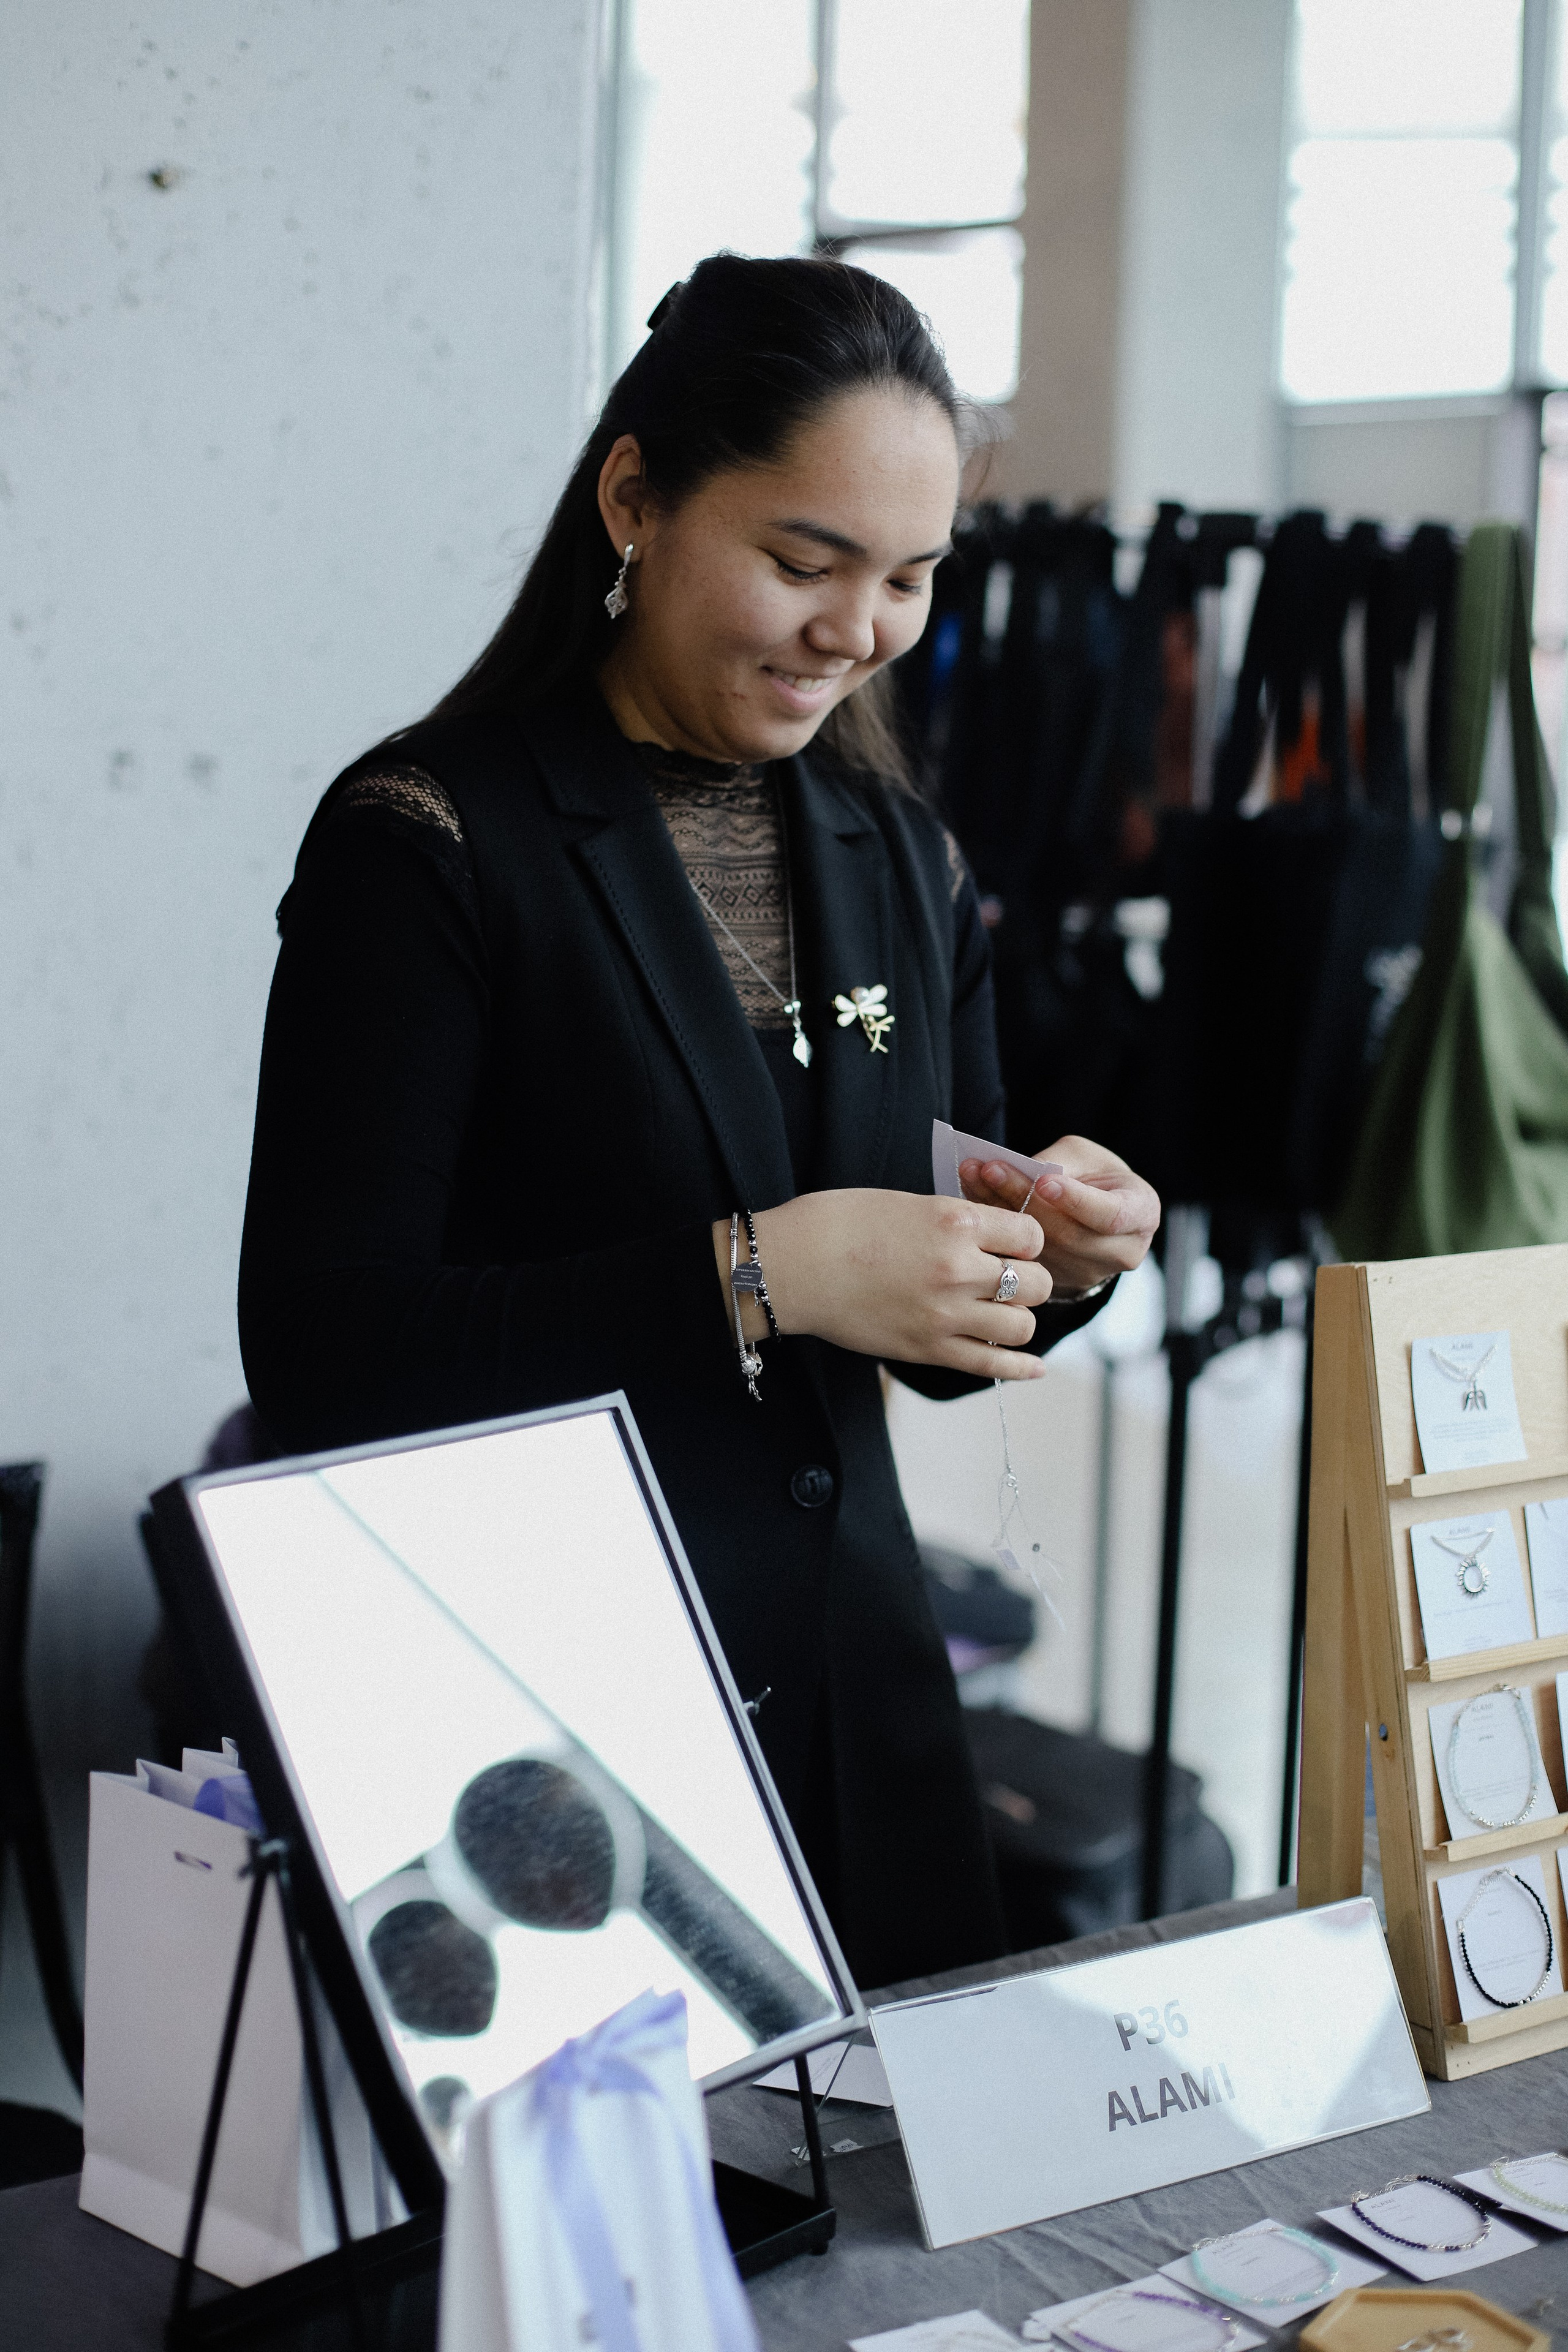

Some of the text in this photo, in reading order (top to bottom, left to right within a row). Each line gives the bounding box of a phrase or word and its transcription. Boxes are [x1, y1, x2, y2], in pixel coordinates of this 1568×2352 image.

[1114, 1999, 1189, 2052] P36
[1108, 2062, 1236, 2132] ALAMI
[1371, 2198, 1396, 2209] ALAMI
